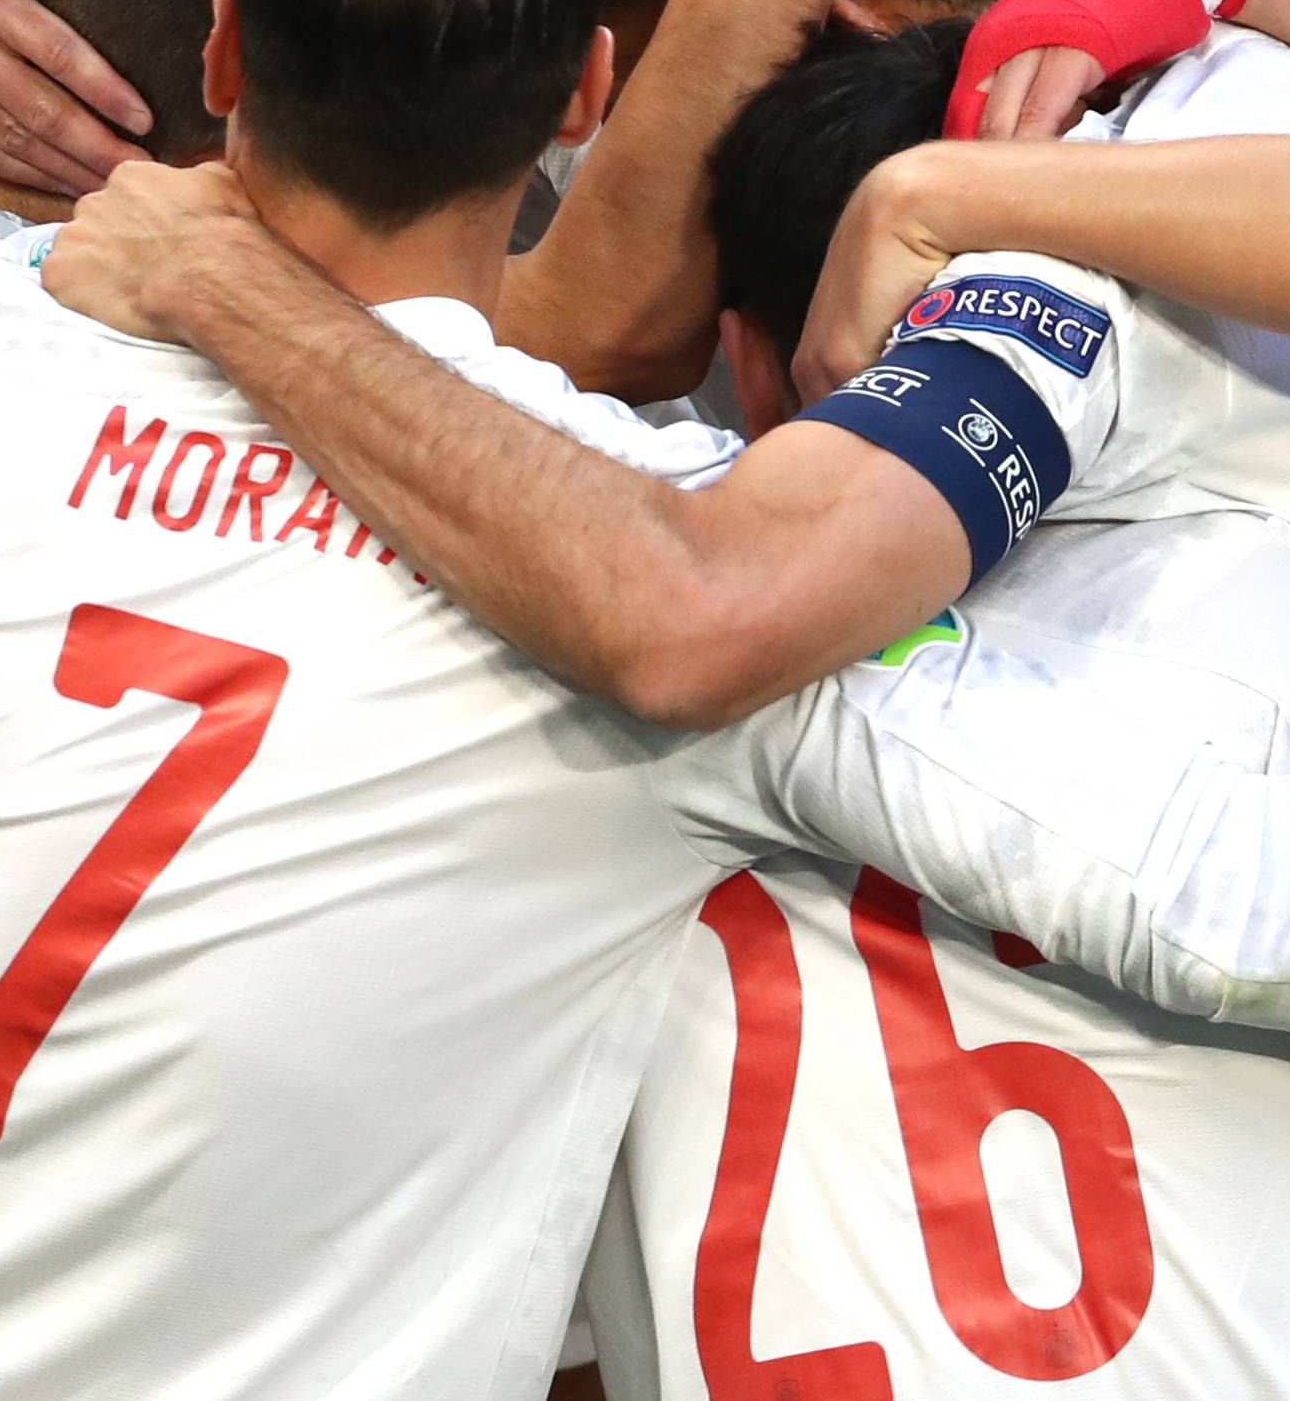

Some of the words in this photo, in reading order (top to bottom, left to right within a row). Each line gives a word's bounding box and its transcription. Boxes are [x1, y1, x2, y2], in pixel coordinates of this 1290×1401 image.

[843, 372, 922, 396] ECT
[955, 289, 1102, 357] RESPECT
[67, 405, 427, 585] MORA
[694, 864, 1155, 1401] 26
